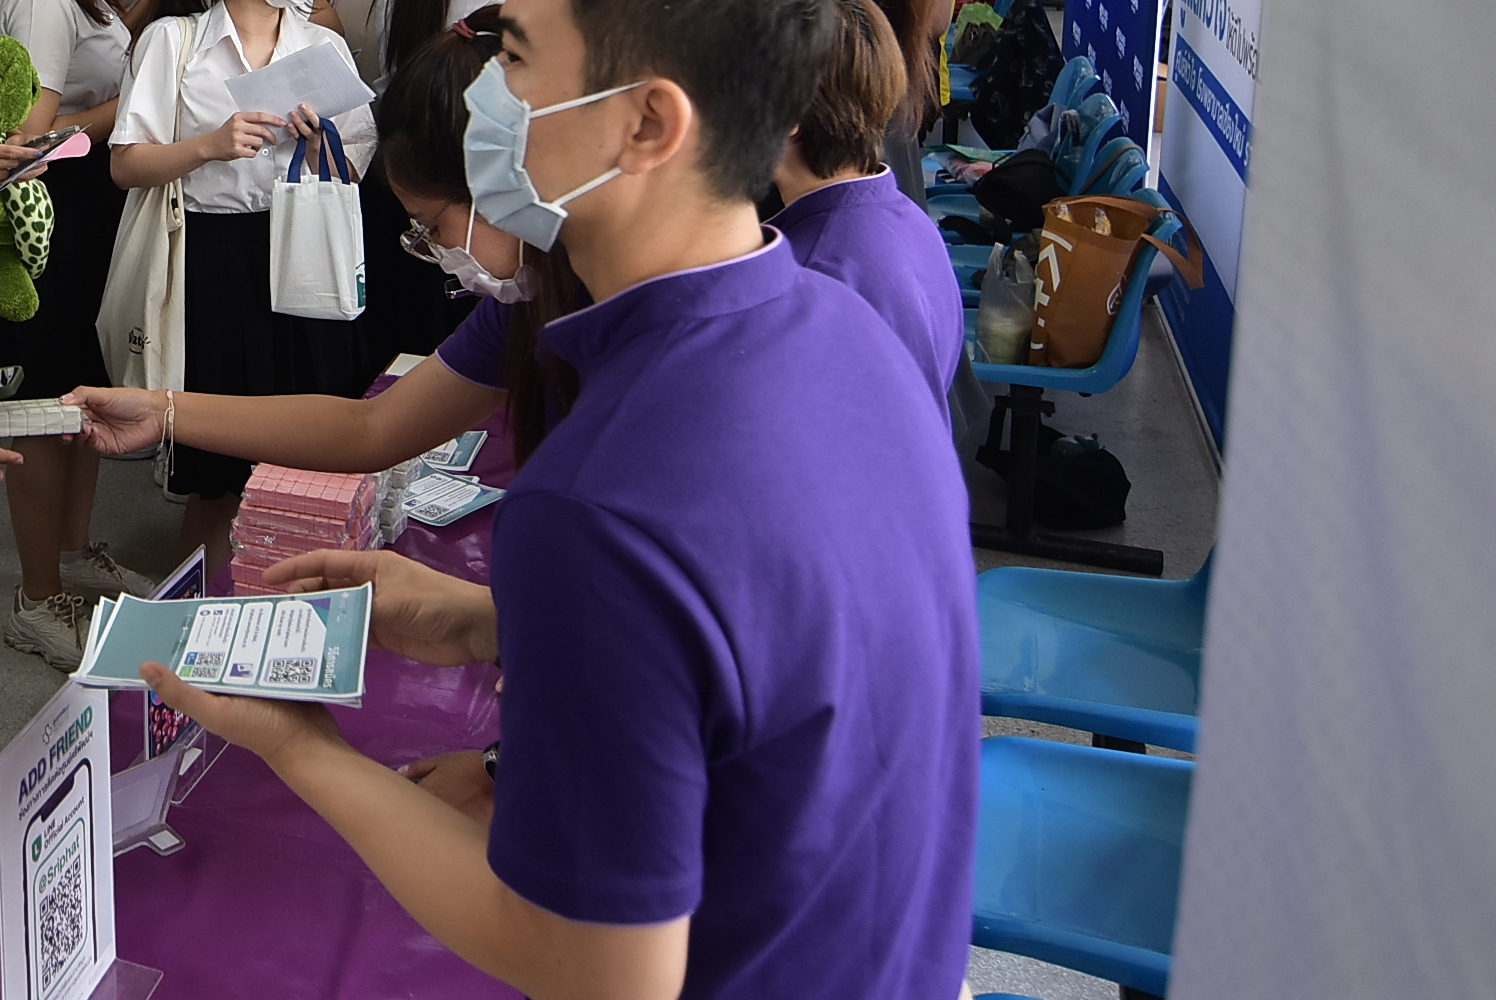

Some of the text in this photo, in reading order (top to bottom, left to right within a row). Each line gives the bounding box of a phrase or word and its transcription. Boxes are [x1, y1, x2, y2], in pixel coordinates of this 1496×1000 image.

[1226, 6, 1260, 81] ให้ดีไปพร้อ
[322, 646, 339, 688] วิธีการสมัคร
[18, 757, 47, 806] ADD
[49, 705, 93, 772] FRIEND
[43, 818, 56, 838] LINE
[44, 796, 85, 850] Official Account
[38, 834, 80, 894] @Sriphat
